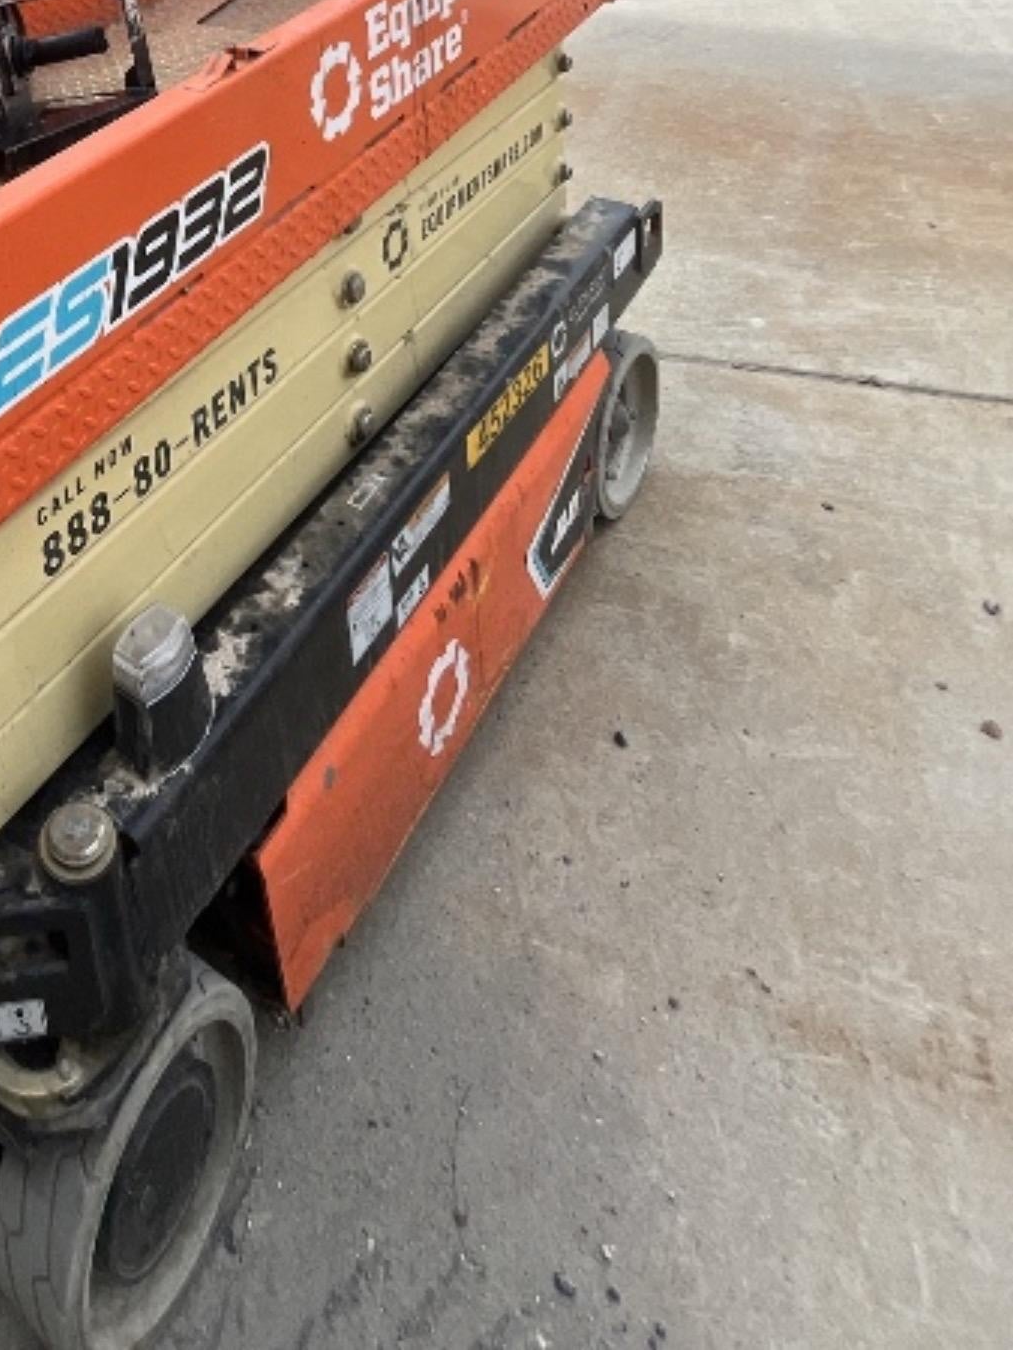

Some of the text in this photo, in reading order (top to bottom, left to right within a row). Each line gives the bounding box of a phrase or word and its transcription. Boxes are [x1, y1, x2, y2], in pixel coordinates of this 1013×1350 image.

[368, 23, 464, 121] Share
[36, 433, 133, 526] CALL NOW
[42, 346, 279, 577] 888-80-RENTS
